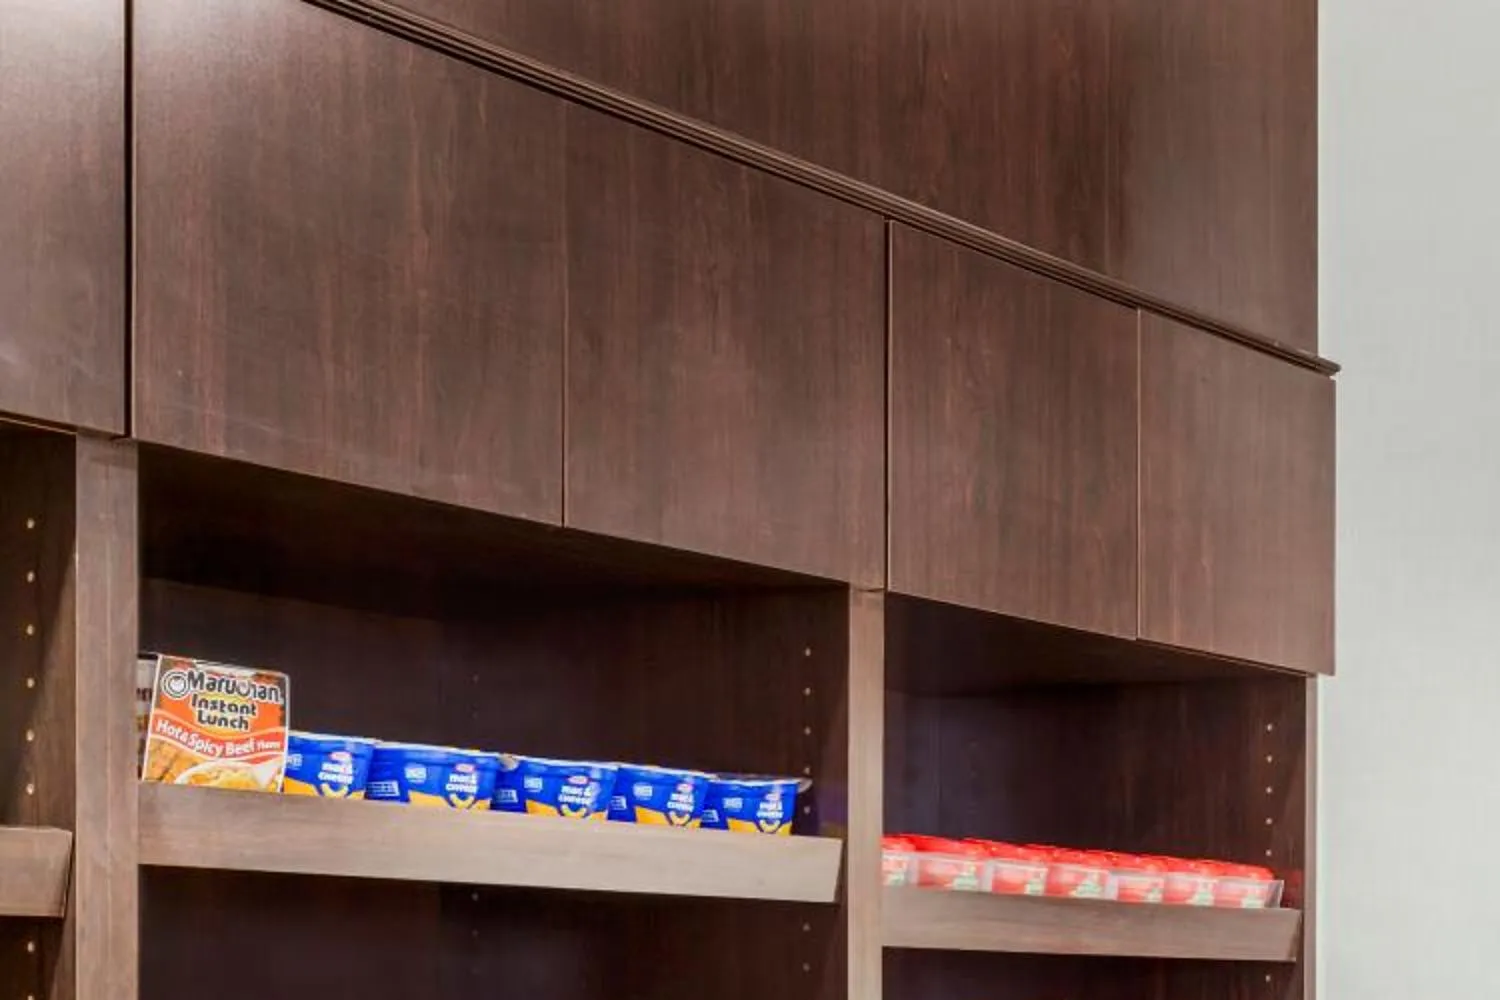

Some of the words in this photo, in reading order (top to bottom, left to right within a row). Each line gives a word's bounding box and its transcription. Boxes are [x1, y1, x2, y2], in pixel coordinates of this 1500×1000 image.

[191, 693, 257, 716] Instant
[197, 710, 249, 730] Lunch
[187, 733, 224, 757] Spicy
[225, 736, 255, 756] Beef
